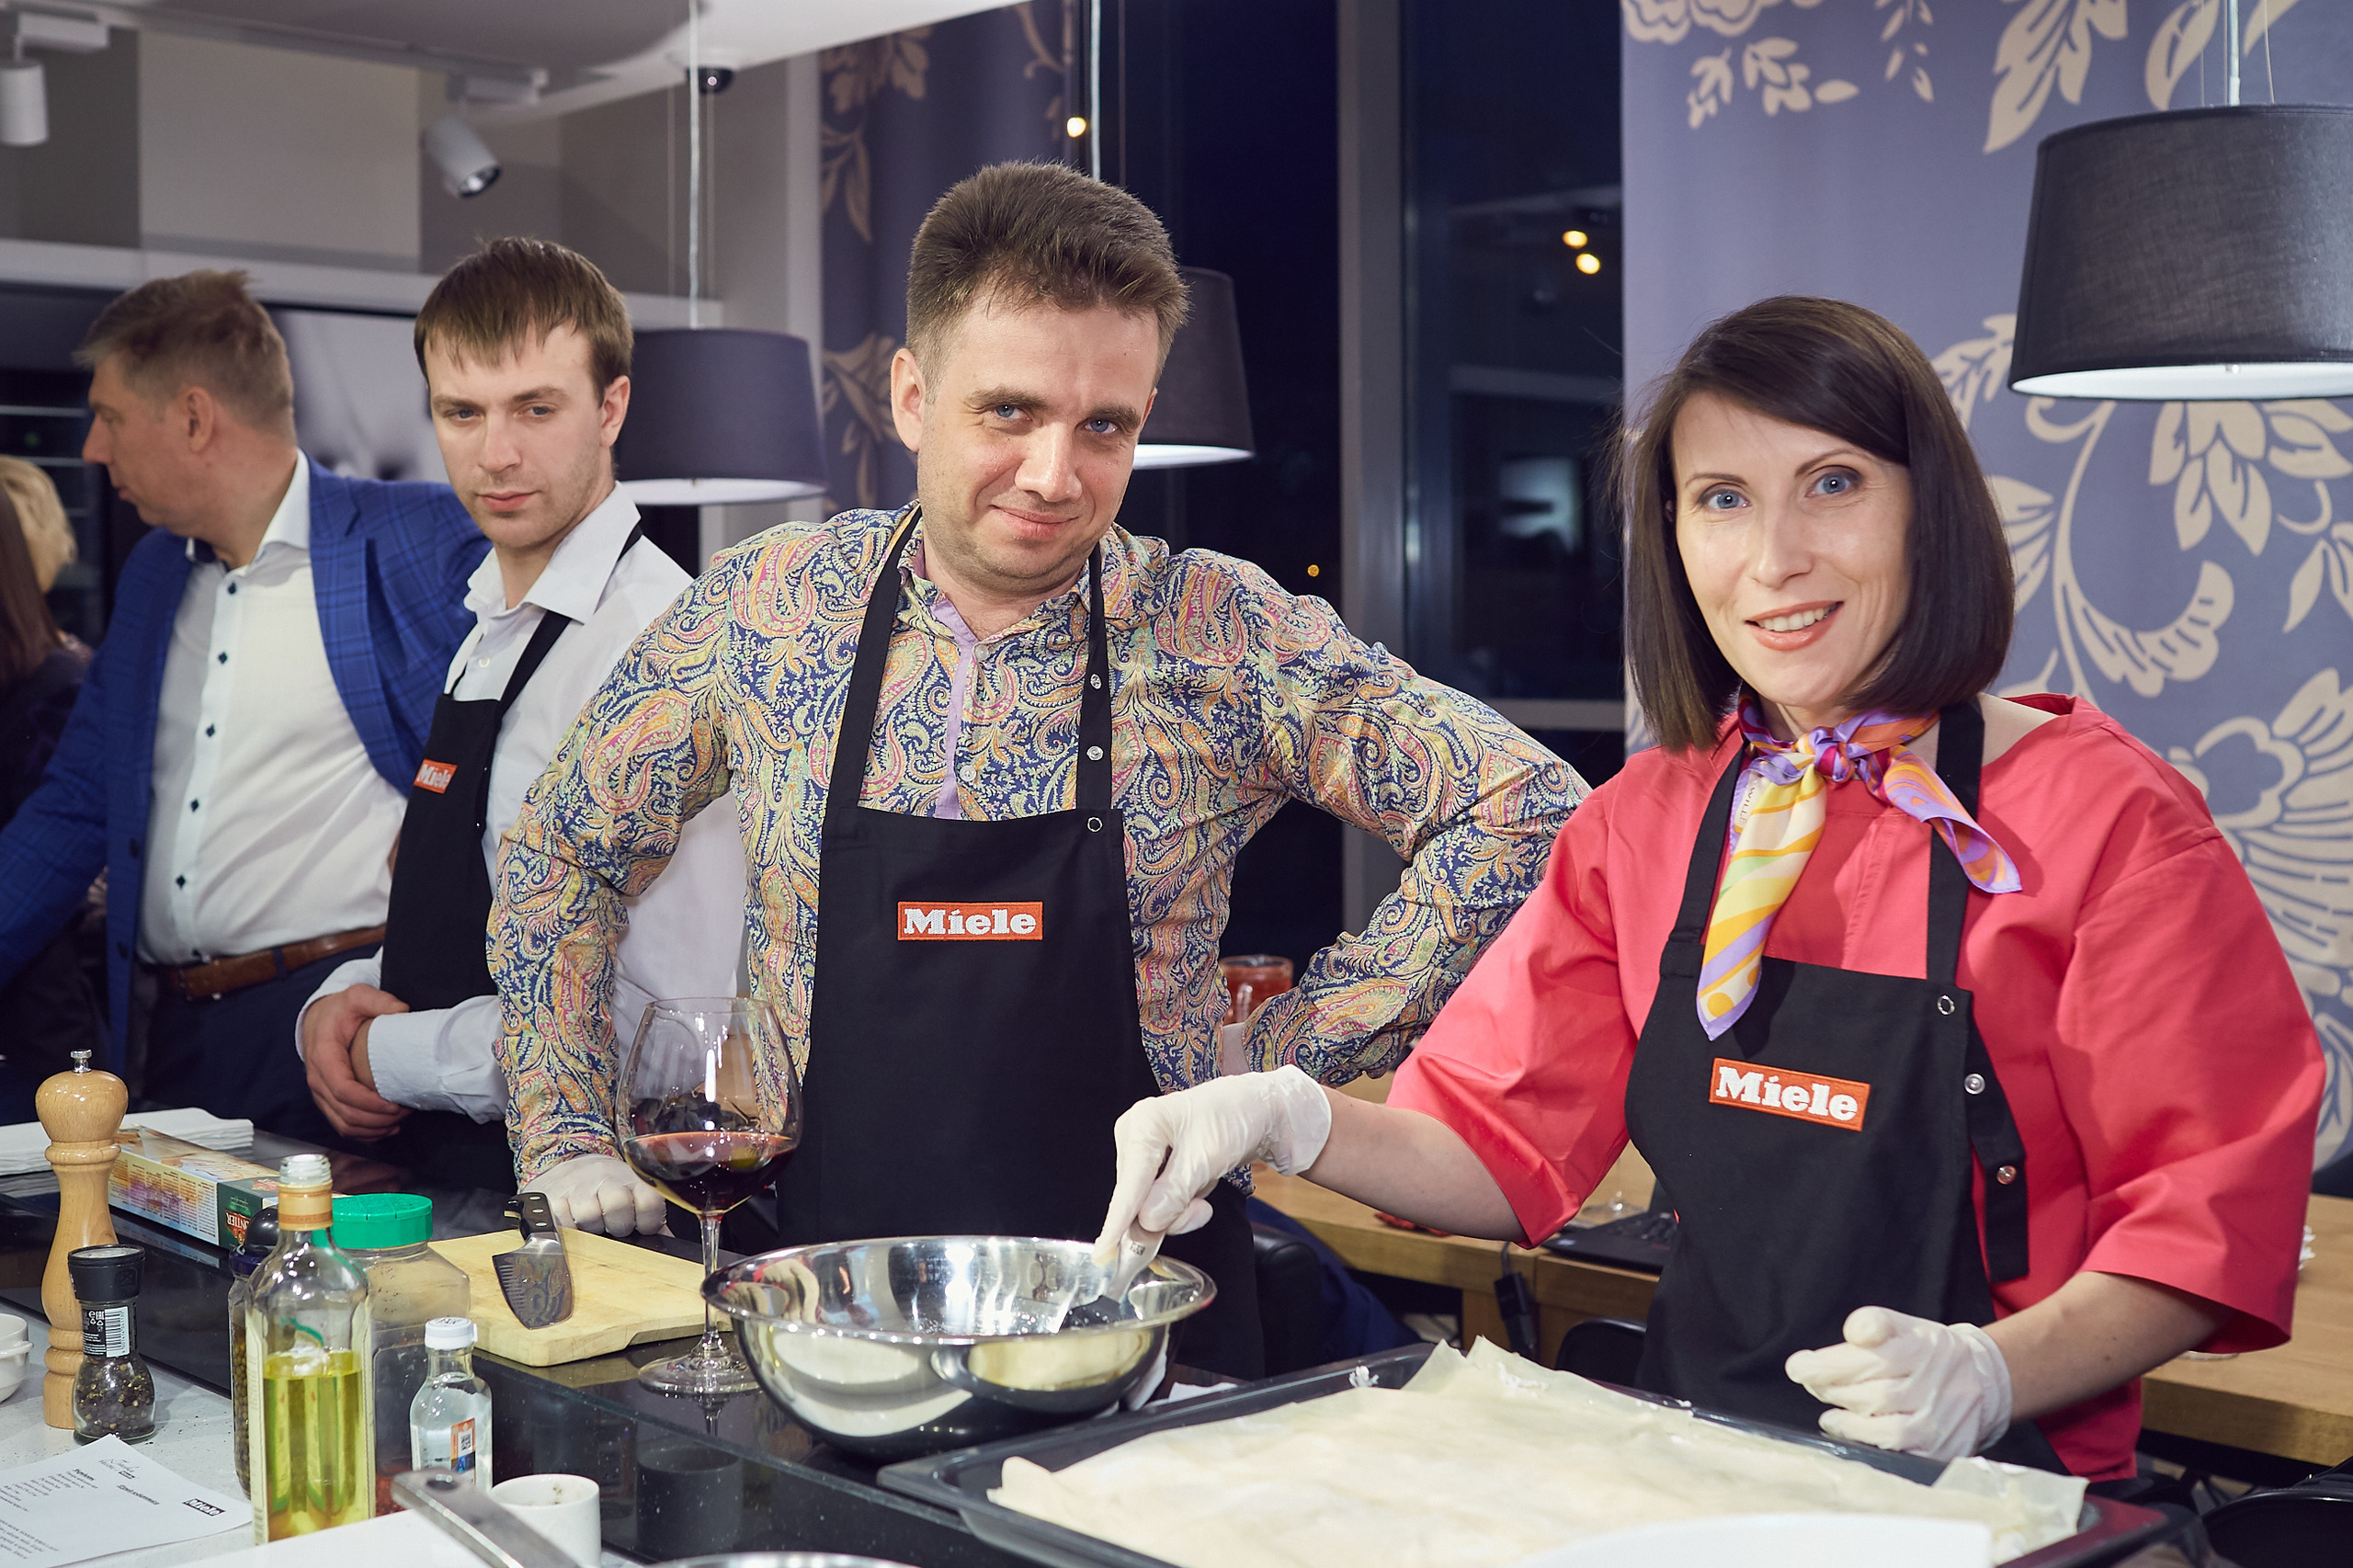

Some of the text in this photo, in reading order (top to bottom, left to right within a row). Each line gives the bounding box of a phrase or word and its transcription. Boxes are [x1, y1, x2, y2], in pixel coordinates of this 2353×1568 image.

[416, 763, 451, 789] Miele
[904, 908, 1037, 935] Miele
[1715, 1066, 1858, 1121] Miele
[225, 1212, 250, 1230] ONTIER
[184, 1499, 222, 1516] Miele
